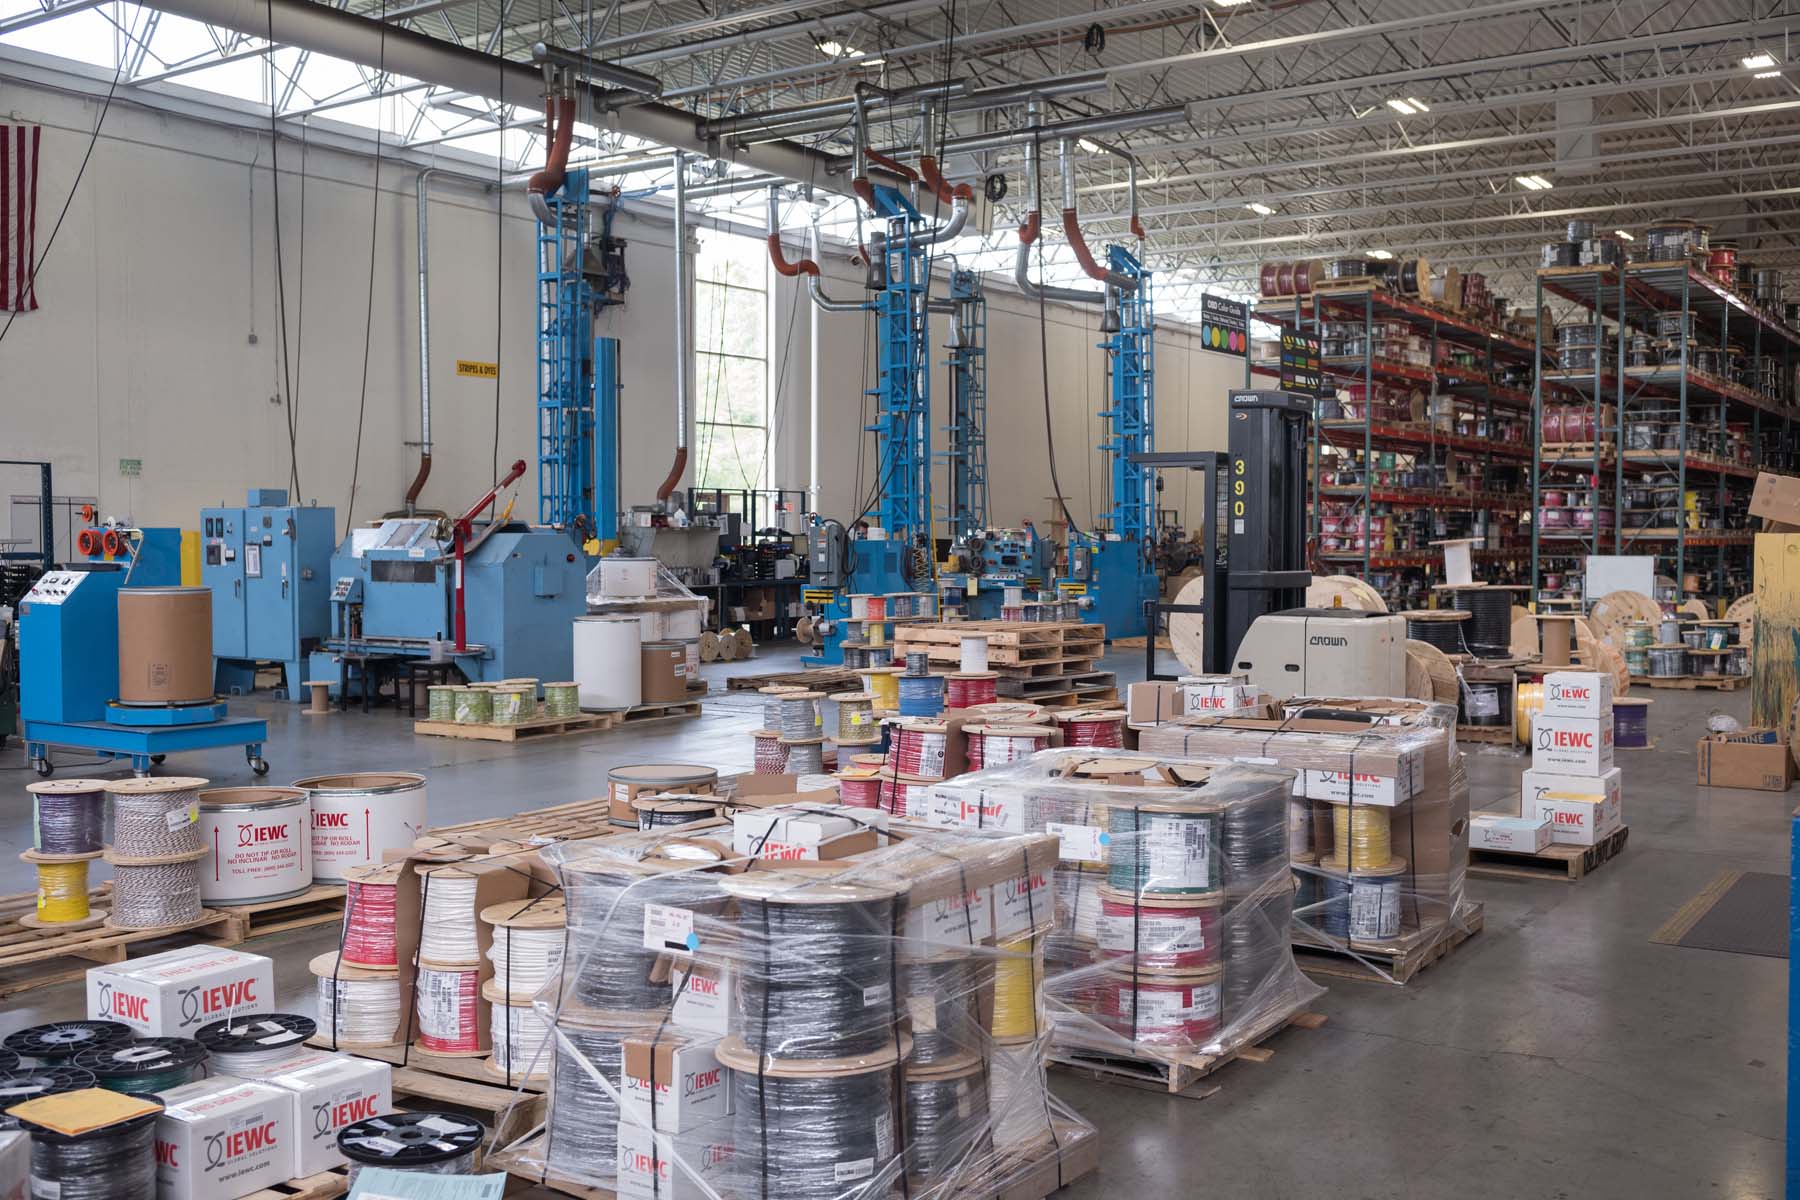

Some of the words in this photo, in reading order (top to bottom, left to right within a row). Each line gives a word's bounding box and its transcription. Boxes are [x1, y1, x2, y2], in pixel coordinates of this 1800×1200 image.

[459, 364, 478, 374] STRIPES
[480, 366, 483, 374] &
[484, 366, 496, 375] DYES
[1310, 636, 1347, 646] CROWN
[1562, 689, 1590, 698] IEWC
[1554, 732, 1592, 748] IEWC
[316, 813, 348, 827] IEWC
[1554, 812, 1583, 825] IEWC
[255, 824, 288, 842] IEWC
[692, 976, 720, 995] IEWC
[203, 978, 257, 1014] IEWC
[113, 991, 149, 1022] IEWC
[204, 1011, 225, 1021] GLOBAL
[695, 1068, 720, 1089] IEWC
[332, 1094, 377, 1128] IEWC
[226, 1121, 276, 1159] IEWC
[155, 1140, 178, 1168] WC
[218, 1160, 270, 1182] www.iewc.com
